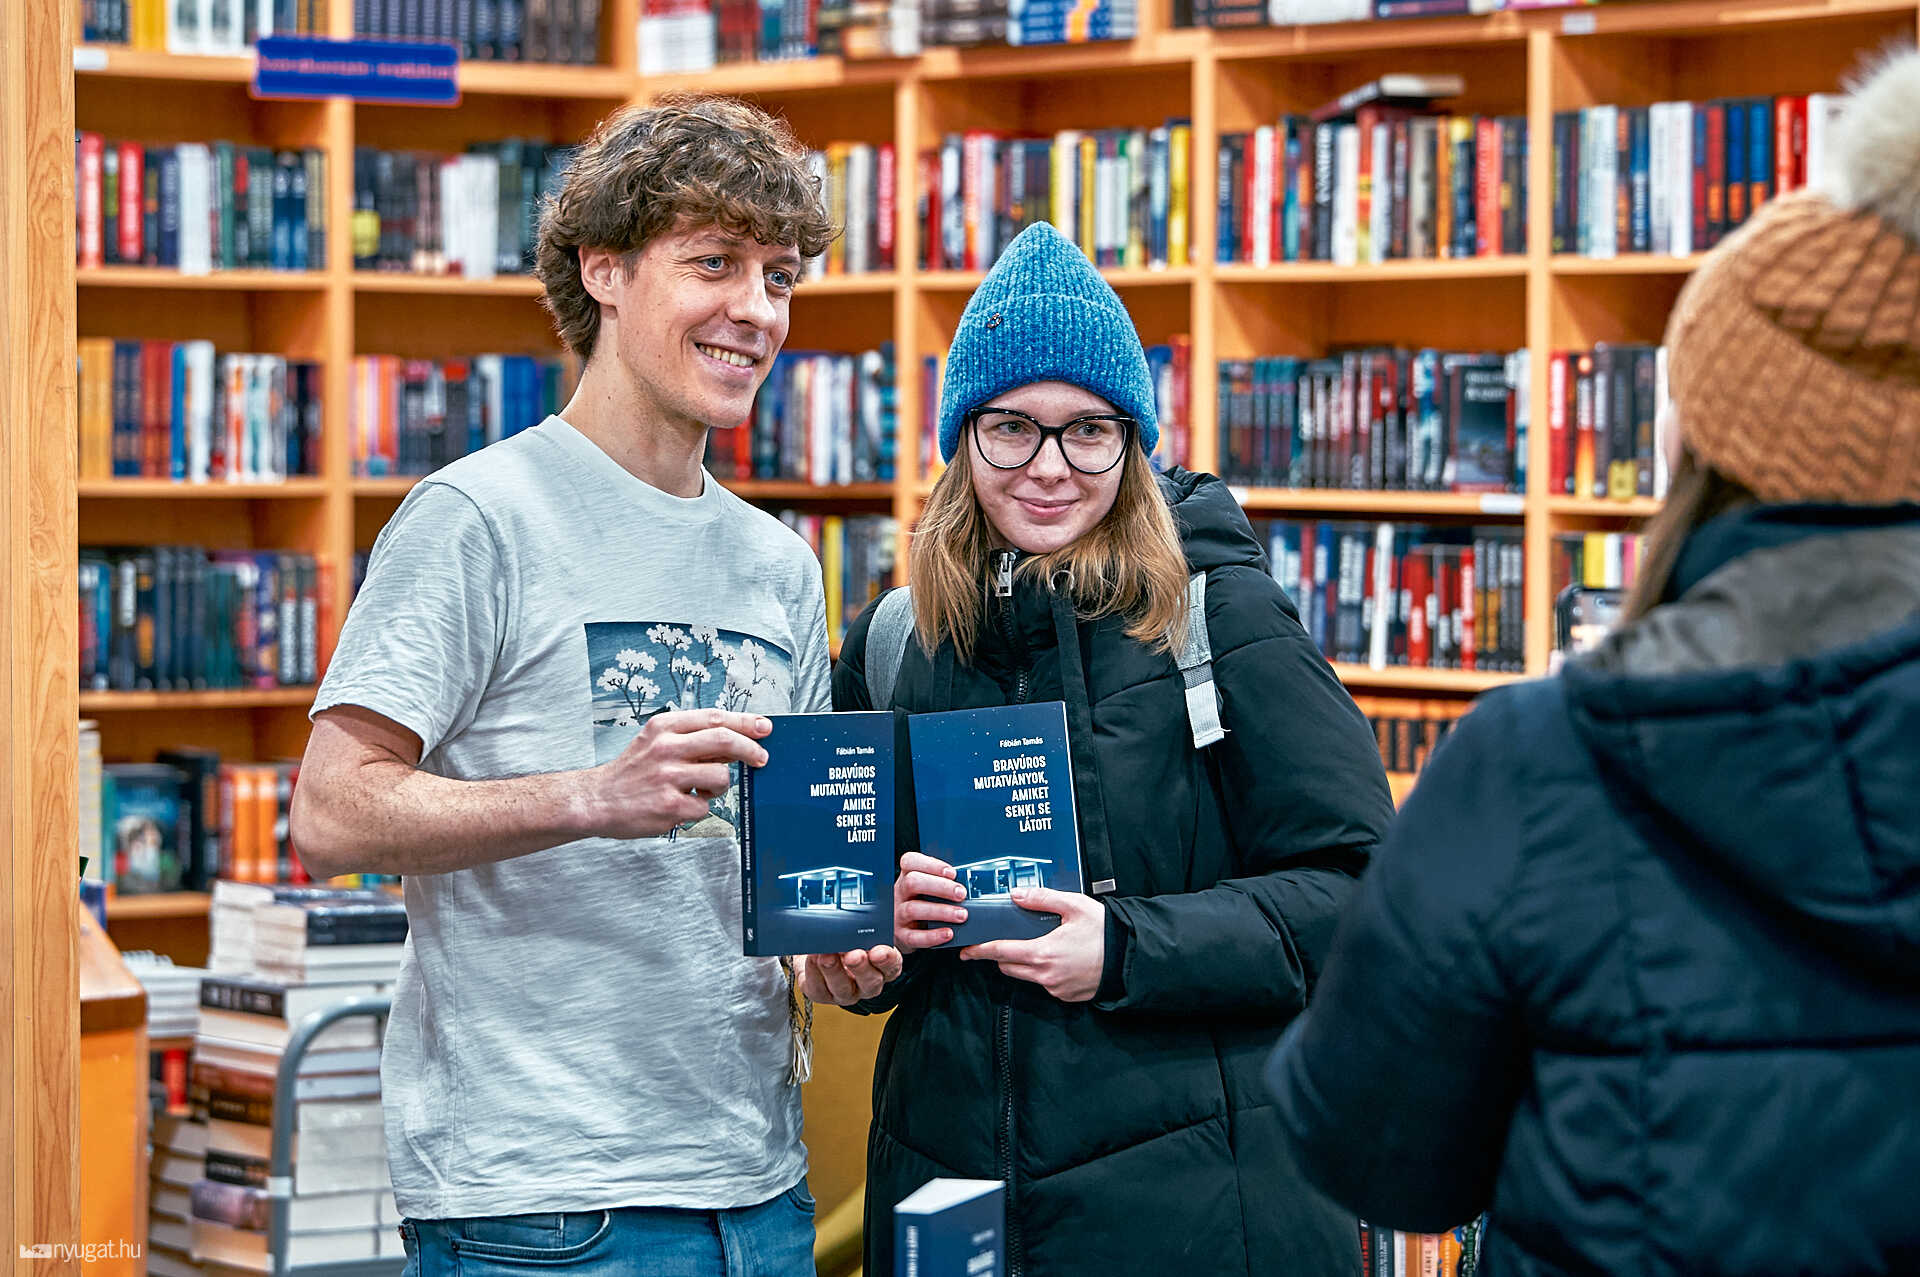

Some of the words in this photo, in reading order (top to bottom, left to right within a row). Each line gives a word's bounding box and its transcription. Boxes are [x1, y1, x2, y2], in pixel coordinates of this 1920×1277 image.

[836, 747, 855, 755] Fábián
[856, 746, 875, 754] Tamás
[999, 739, 1021, 748] Fábián
[1022, 737, 1043, 746] Tamás
[828, 762, 876, 780] BRAVÚROS
[993, 753, 1046, 773] BRAVÚROS
[810, 779, 876, 797] MUTATVÁNYOK,
[973, 770, 1048, 790] MUTATVÁNYOK,
[1012, 786, 1049, 801] AMIKET
[843, 797, 876, 811] AMIKET
[1005, 803, 1035, 818] SENKI
[1037, 801, 1051, 815] SE
[836, 814, 863, 828] SENKI
[864, 813, 876, 826] SE
[1019, 816, 1052, 833] LÁTOTT
[847, 826, 876, 843] LÁTOTT
